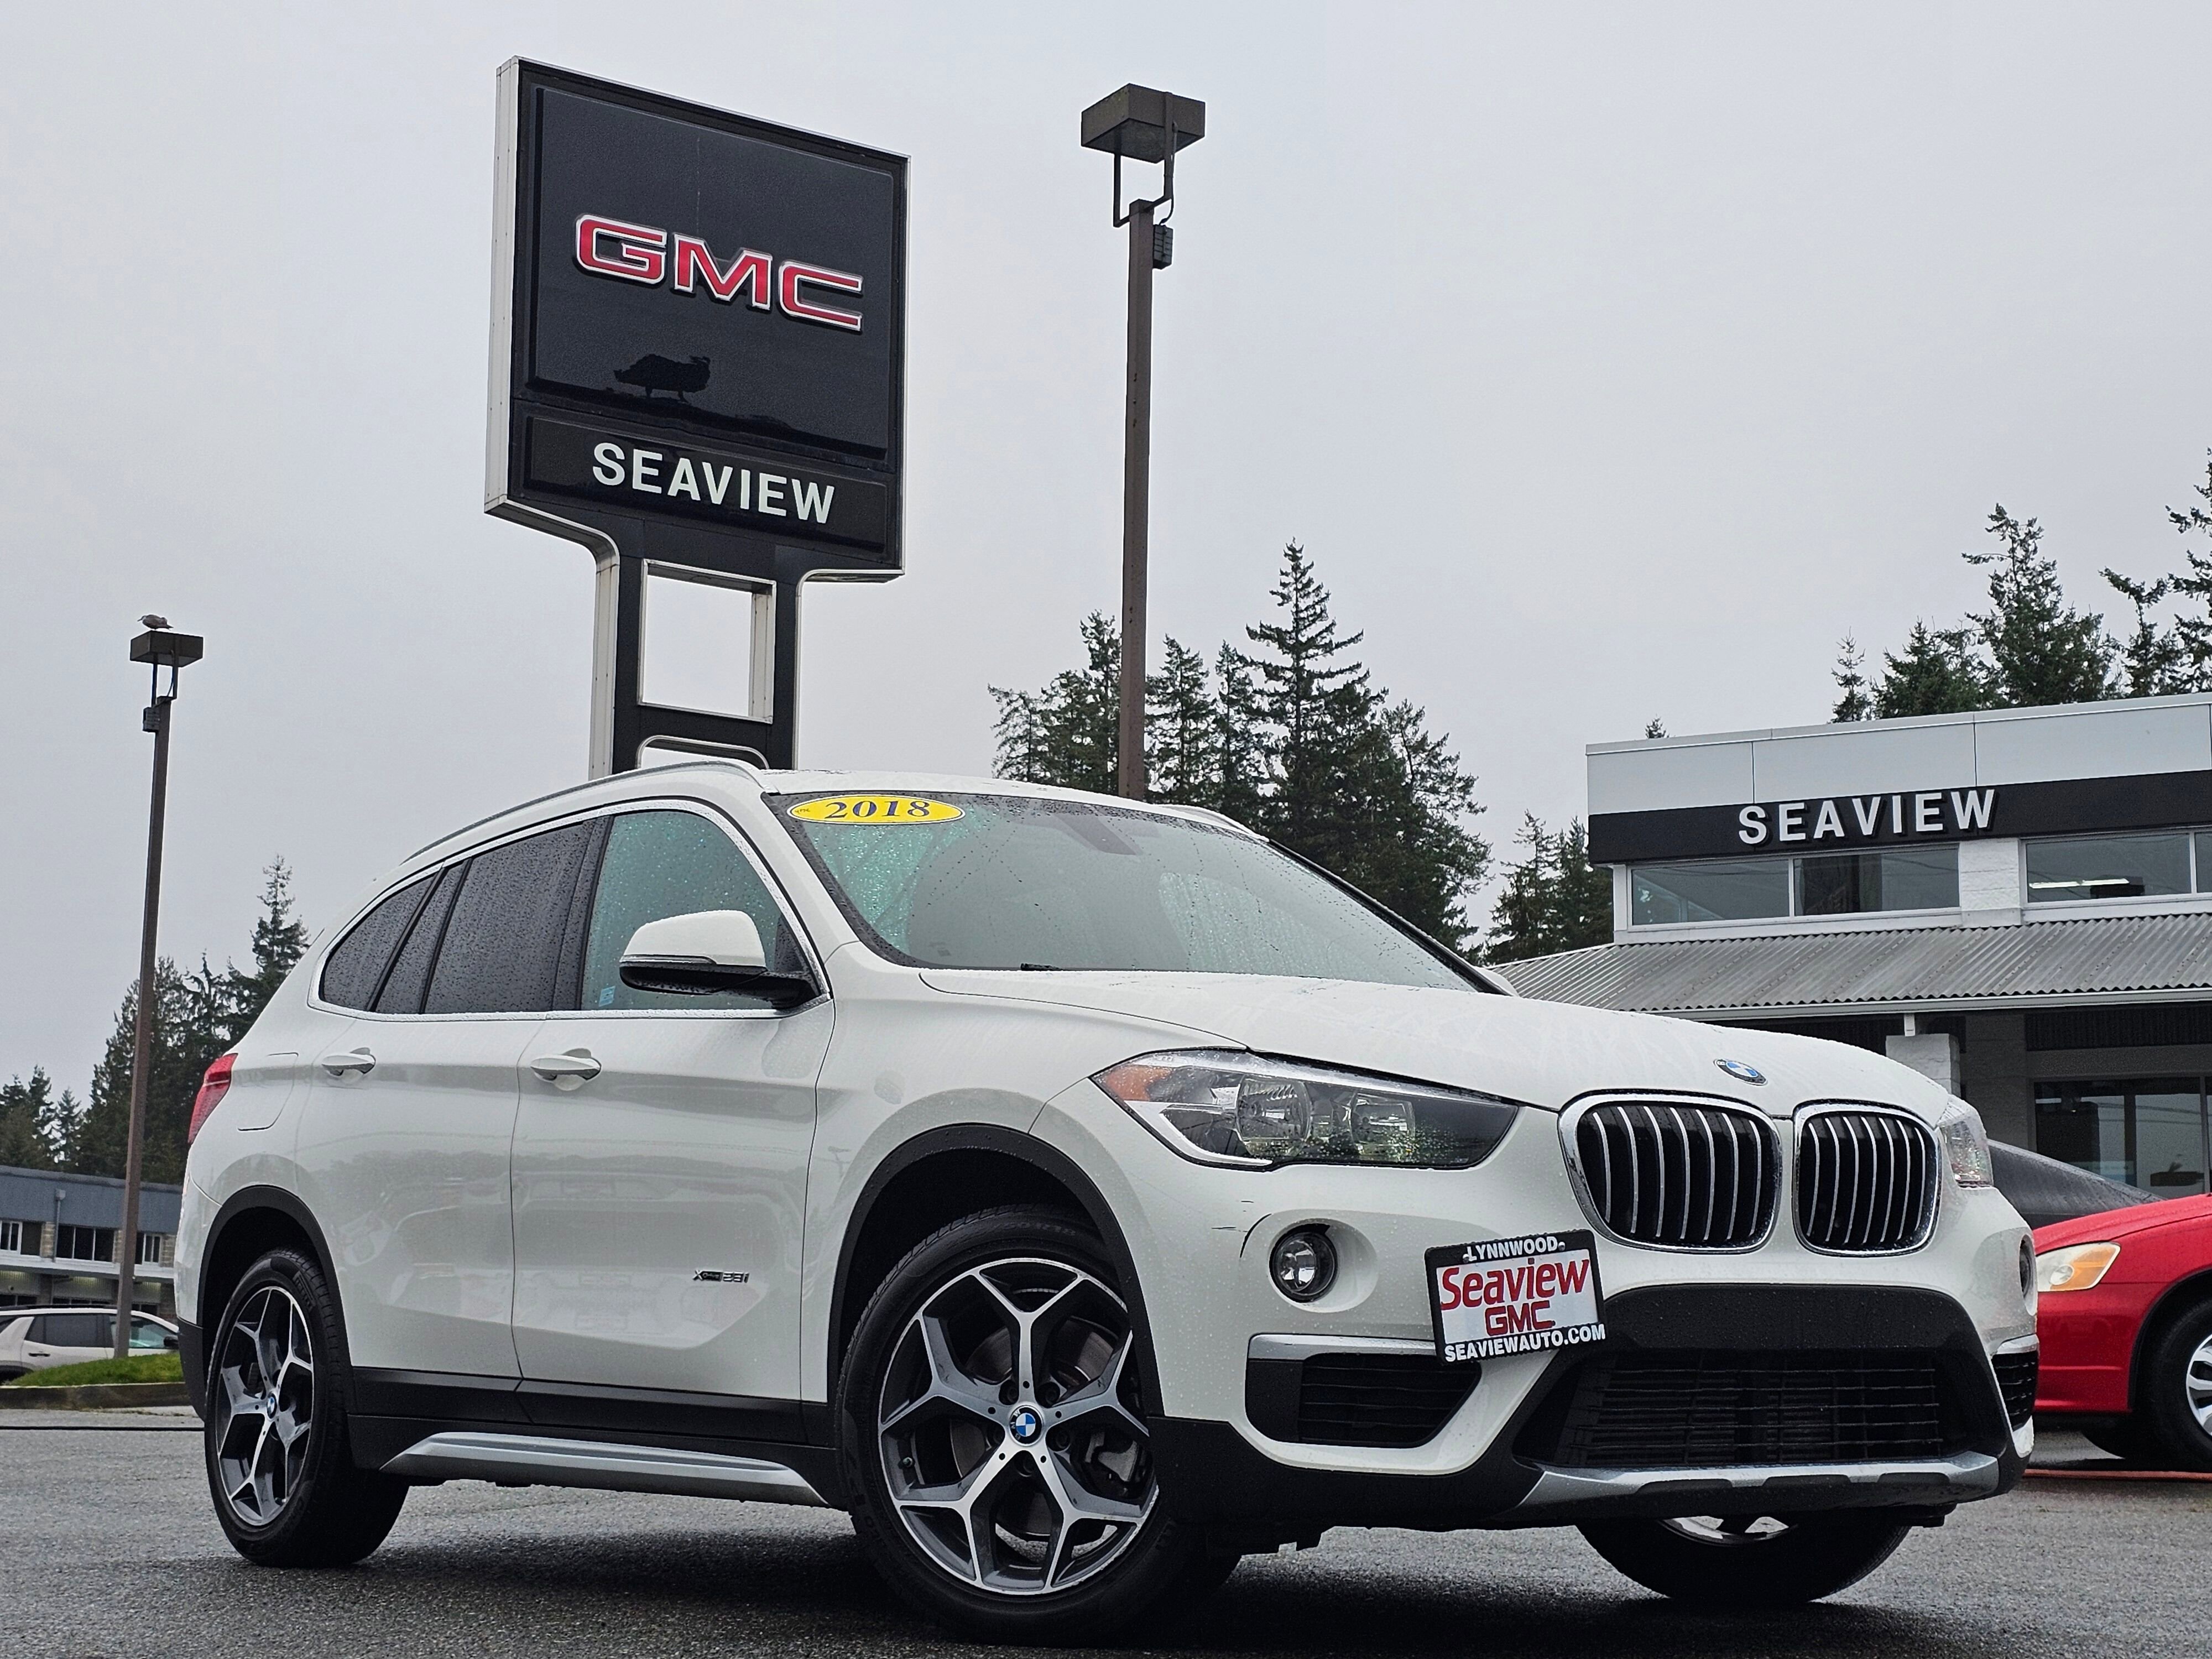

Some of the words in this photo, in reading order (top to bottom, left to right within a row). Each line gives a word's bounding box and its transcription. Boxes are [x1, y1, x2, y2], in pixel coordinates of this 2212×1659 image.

[574, 213, 863, 332] GMC
[592, 442, 835, 524] SEAVIEW
[824, 800, 930, 820] 2018
[1739, 789, 1995, 845] SEAVIEW
[1467, 1237, 1558, 1262] LYNNWOOD
[1440, 1258, 1589, 1311] Seaview
[1485, 1300, 1556, 1336] GMC
[1444, 1324, 1606, 1363] SEAVIEWAUTO.COM
